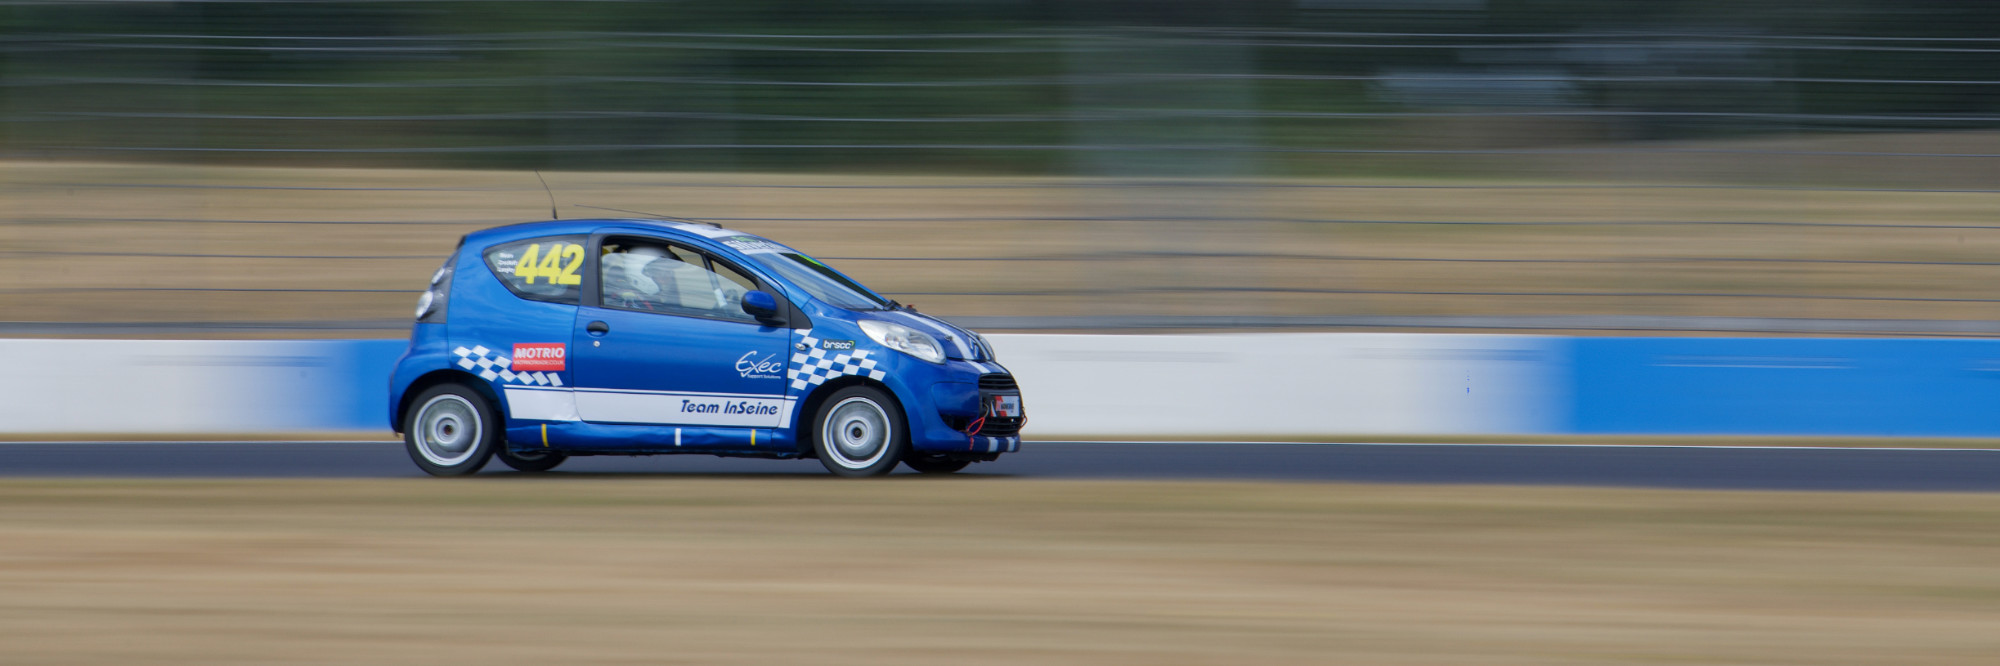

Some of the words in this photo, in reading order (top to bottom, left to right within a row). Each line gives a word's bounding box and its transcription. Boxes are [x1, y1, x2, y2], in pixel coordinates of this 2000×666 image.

[514, 243, 585, 285] 442
[514, 347, 565, 359] MOTRIO
[823, 339, 851, 350] brscc
[735, 350, 782, 378] Exec
[681, 399, 720, 414] Team
[724, 400, 778, 416] InSeine
